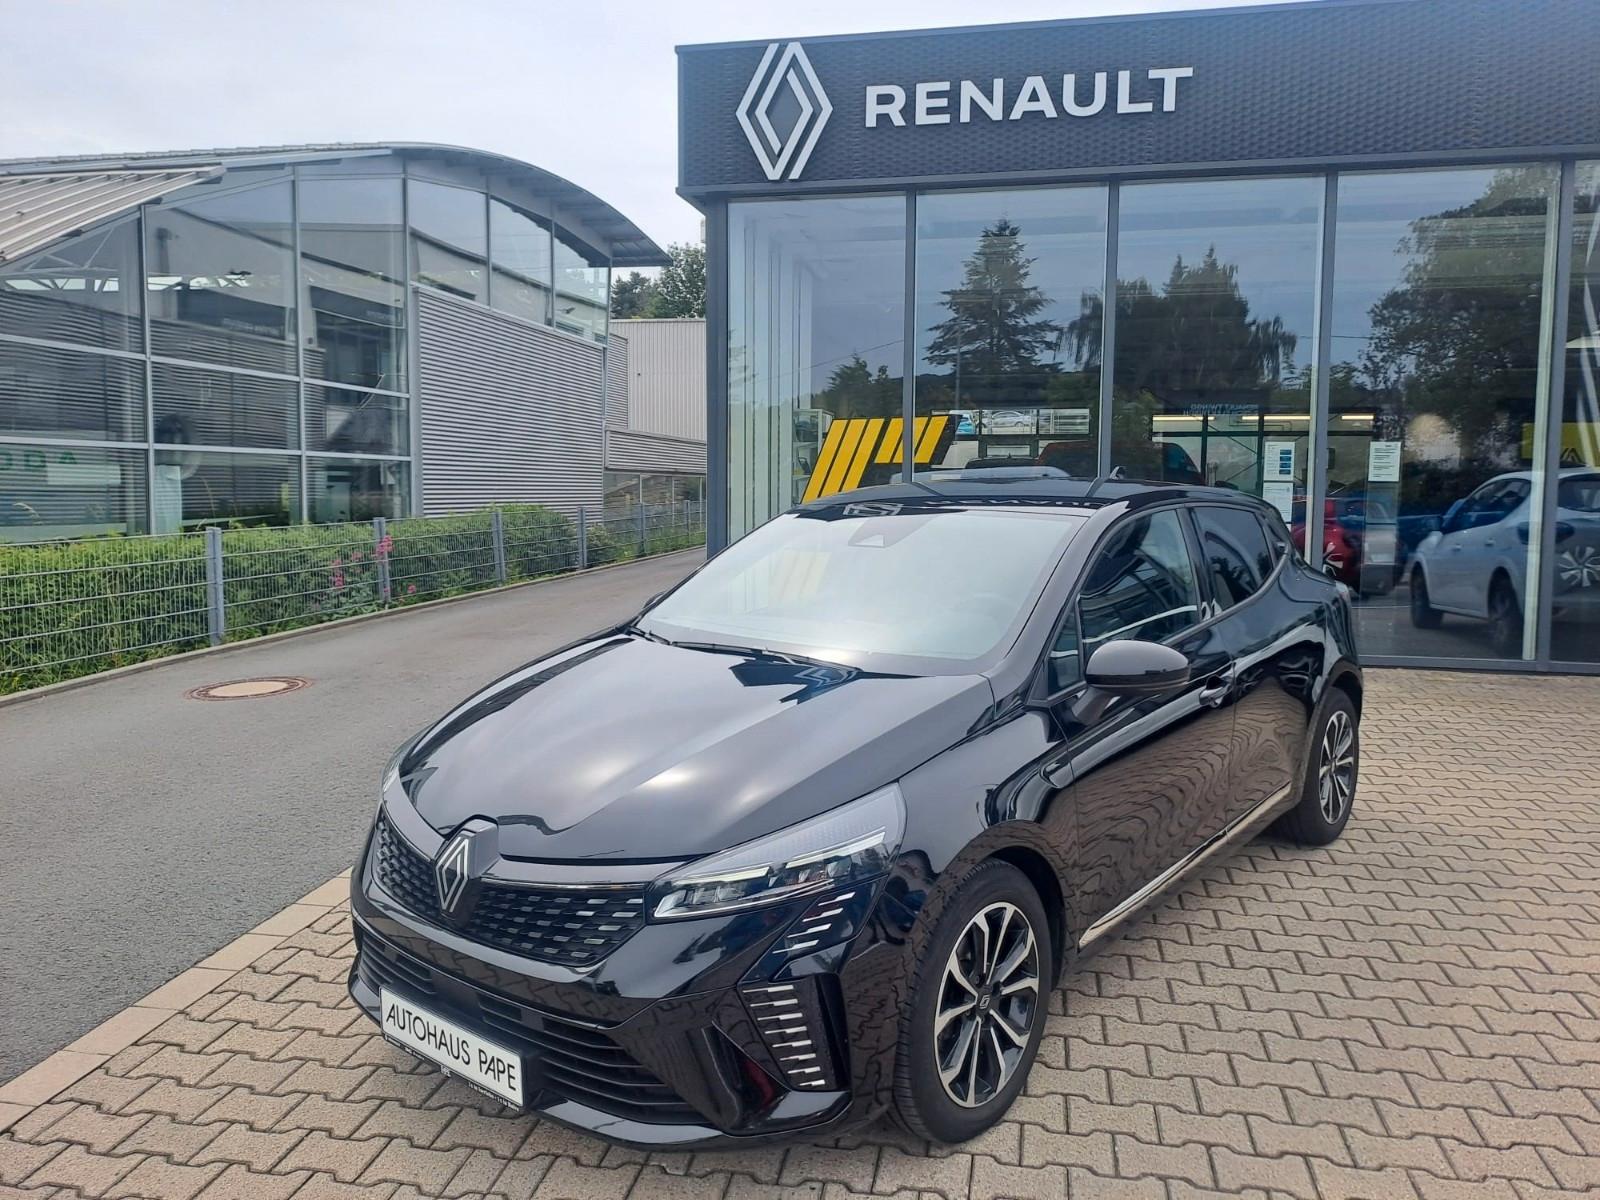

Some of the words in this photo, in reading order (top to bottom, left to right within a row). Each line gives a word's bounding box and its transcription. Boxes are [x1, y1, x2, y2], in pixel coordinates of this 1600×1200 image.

[865, 66, 1194, 128] RENAULT
[386, 1003, 471, 1065] AUTOHAUS
[478, 1048, 517, 1091] PAPE
